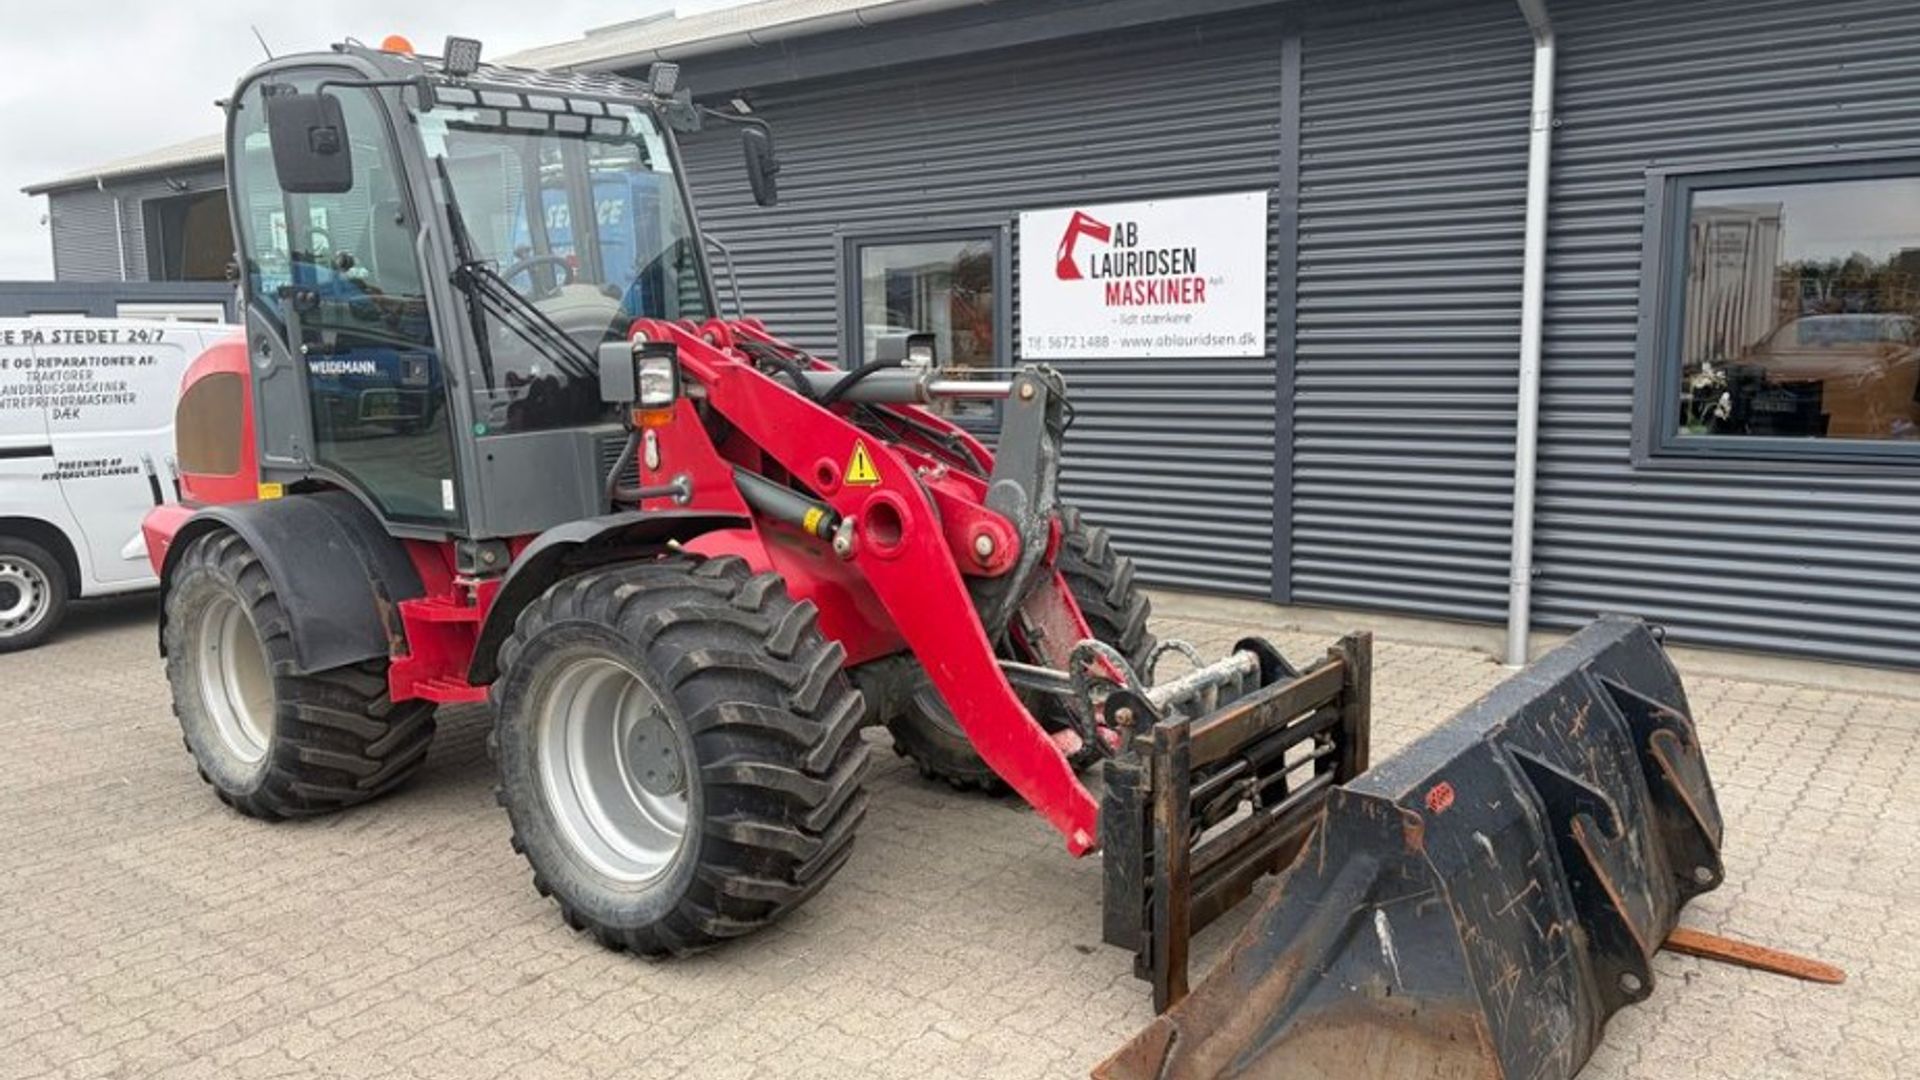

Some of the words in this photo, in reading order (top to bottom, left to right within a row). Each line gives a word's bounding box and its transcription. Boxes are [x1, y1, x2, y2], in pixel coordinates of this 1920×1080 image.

[1113, 221, 1138, 248] AB
[1091, 247, 1197, 279] LAURIDSEN
[1105, 277, 1206, 307] MASKINER
[1120, 312, 1138, 325] lidt
[1141, 312, 1193, 324] stærkere
[52, 329, 119, 344] STEDET
[127, 328, 164, 344] 24/7
[14, 358, 32, 369] OG
[36, 356, 136, 368] REPARATIONER
[309, 360, 376, 375] WEIDEMANN
[26, 369, 94, 381] TRAKTORER
[0, 381, 128, 396] ANDBRUGSMASKINER
[52, 407, 80, 420] DÆK
[110, 457, 122, 466] AF
